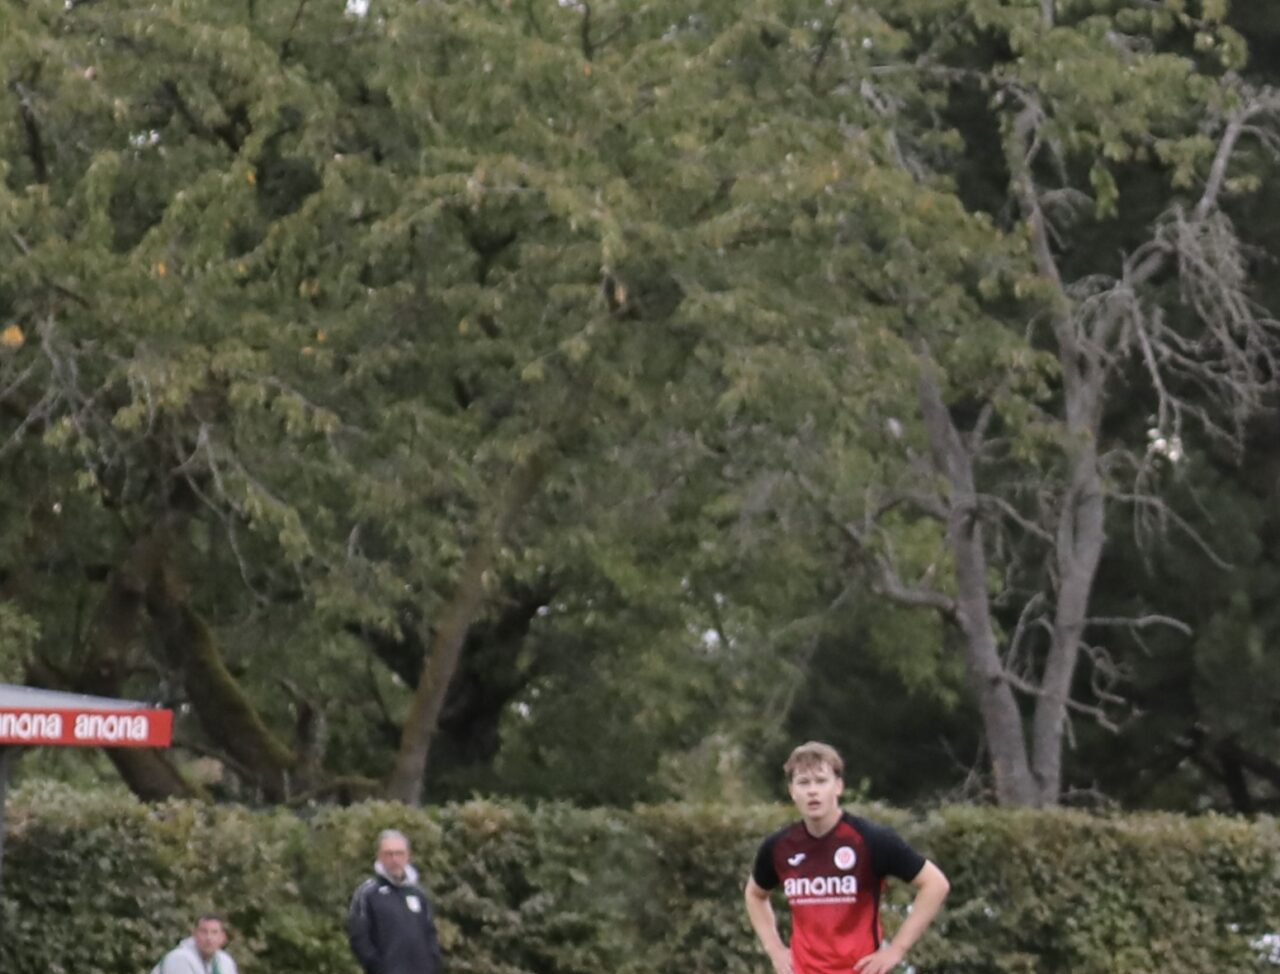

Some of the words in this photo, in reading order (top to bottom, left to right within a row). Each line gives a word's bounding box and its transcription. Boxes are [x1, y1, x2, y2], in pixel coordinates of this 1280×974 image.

[0, 713, 62, 739] nona
[74, 714, 148, 740] anona
[783, 875, 857, 896] anona
